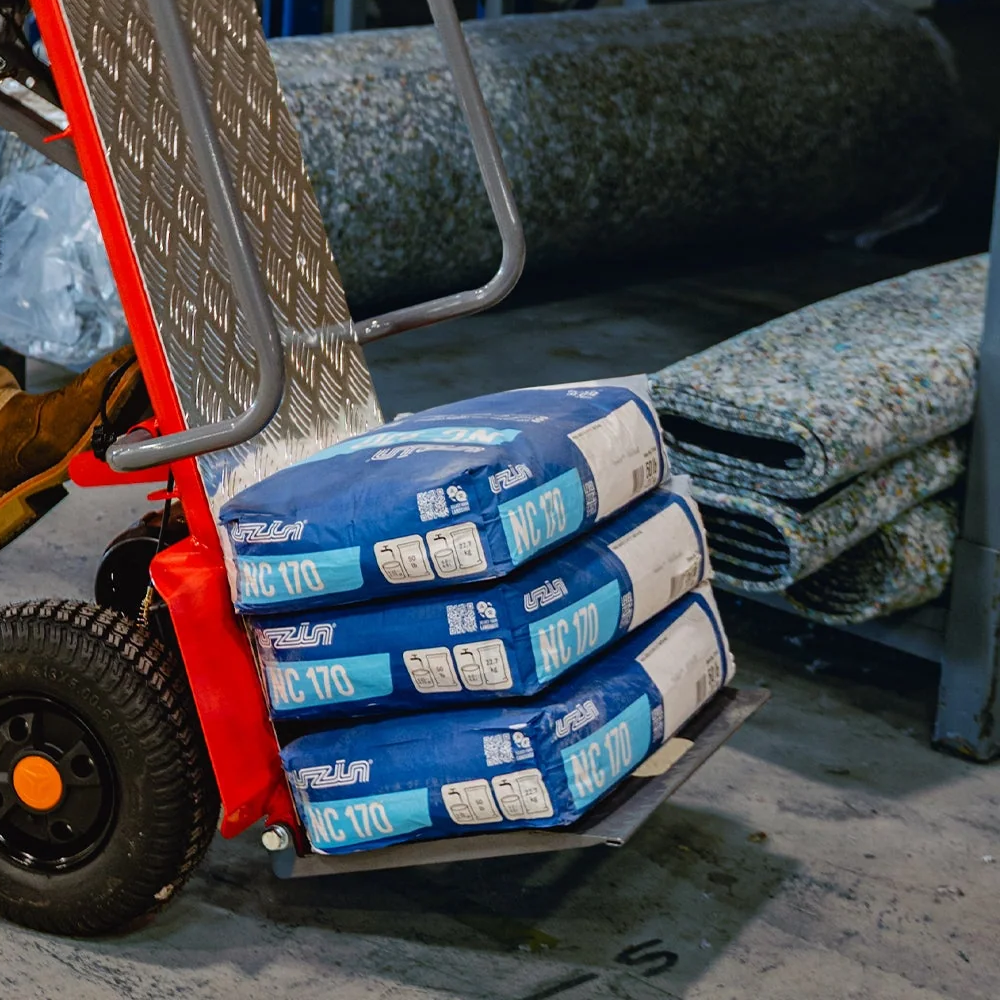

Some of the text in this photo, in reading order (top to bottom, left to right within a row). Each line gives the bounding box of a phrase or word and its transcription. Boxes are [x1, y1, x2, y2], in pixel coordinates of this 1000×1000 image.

[508, 501, 541, 554] NC
[242, 559, 325, 597] NC 170
[538, 619, 571, 672] NC
[573, 602, 599, 655] 170
[269, 664, 354, 704] NC 170
[571, 742, 605, 797] NC
[604, 722, 632, 777] 170
[309, 802, 393, 843] NC 170
